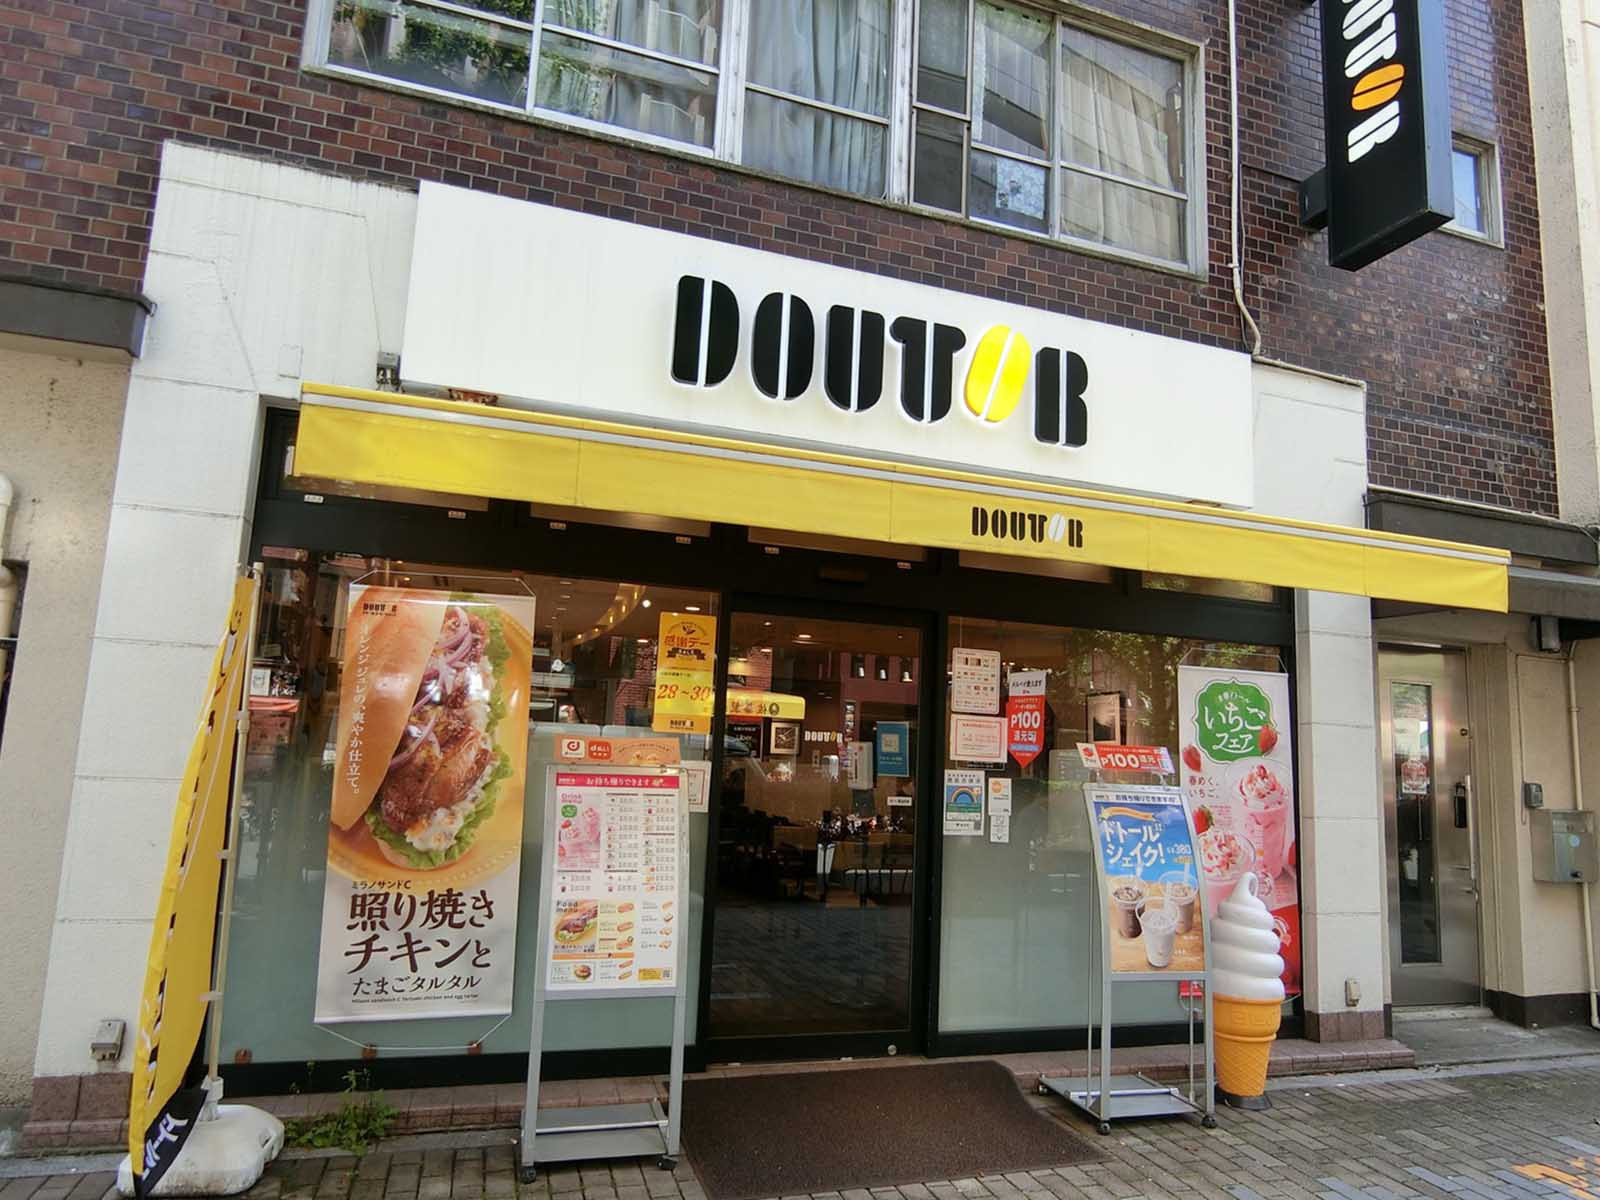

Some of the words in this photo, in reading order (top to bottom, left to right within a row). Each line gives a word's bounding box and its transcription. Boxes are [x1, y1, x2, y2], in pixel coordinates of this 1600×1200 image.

[1342, 0, 1405, 163] UTOR
[671, 275, 1089, 447] DOUTOR
[971, 506, 1084, 548] DOUTOR
[363, 603, 397, 612] DOUTR
[1204, 701, 1267, 733] いちご
[1212, 732, 1254, 754] フェア
[1103, 820, 1161, 843] ドトール
[351, 880, 412, 890] ミラノサンドC
[346, 888, 495, 932] 照り焼き
[344, 931, 492, 974] チキンと
[352, 975, 482, 997] たまごタルタル
